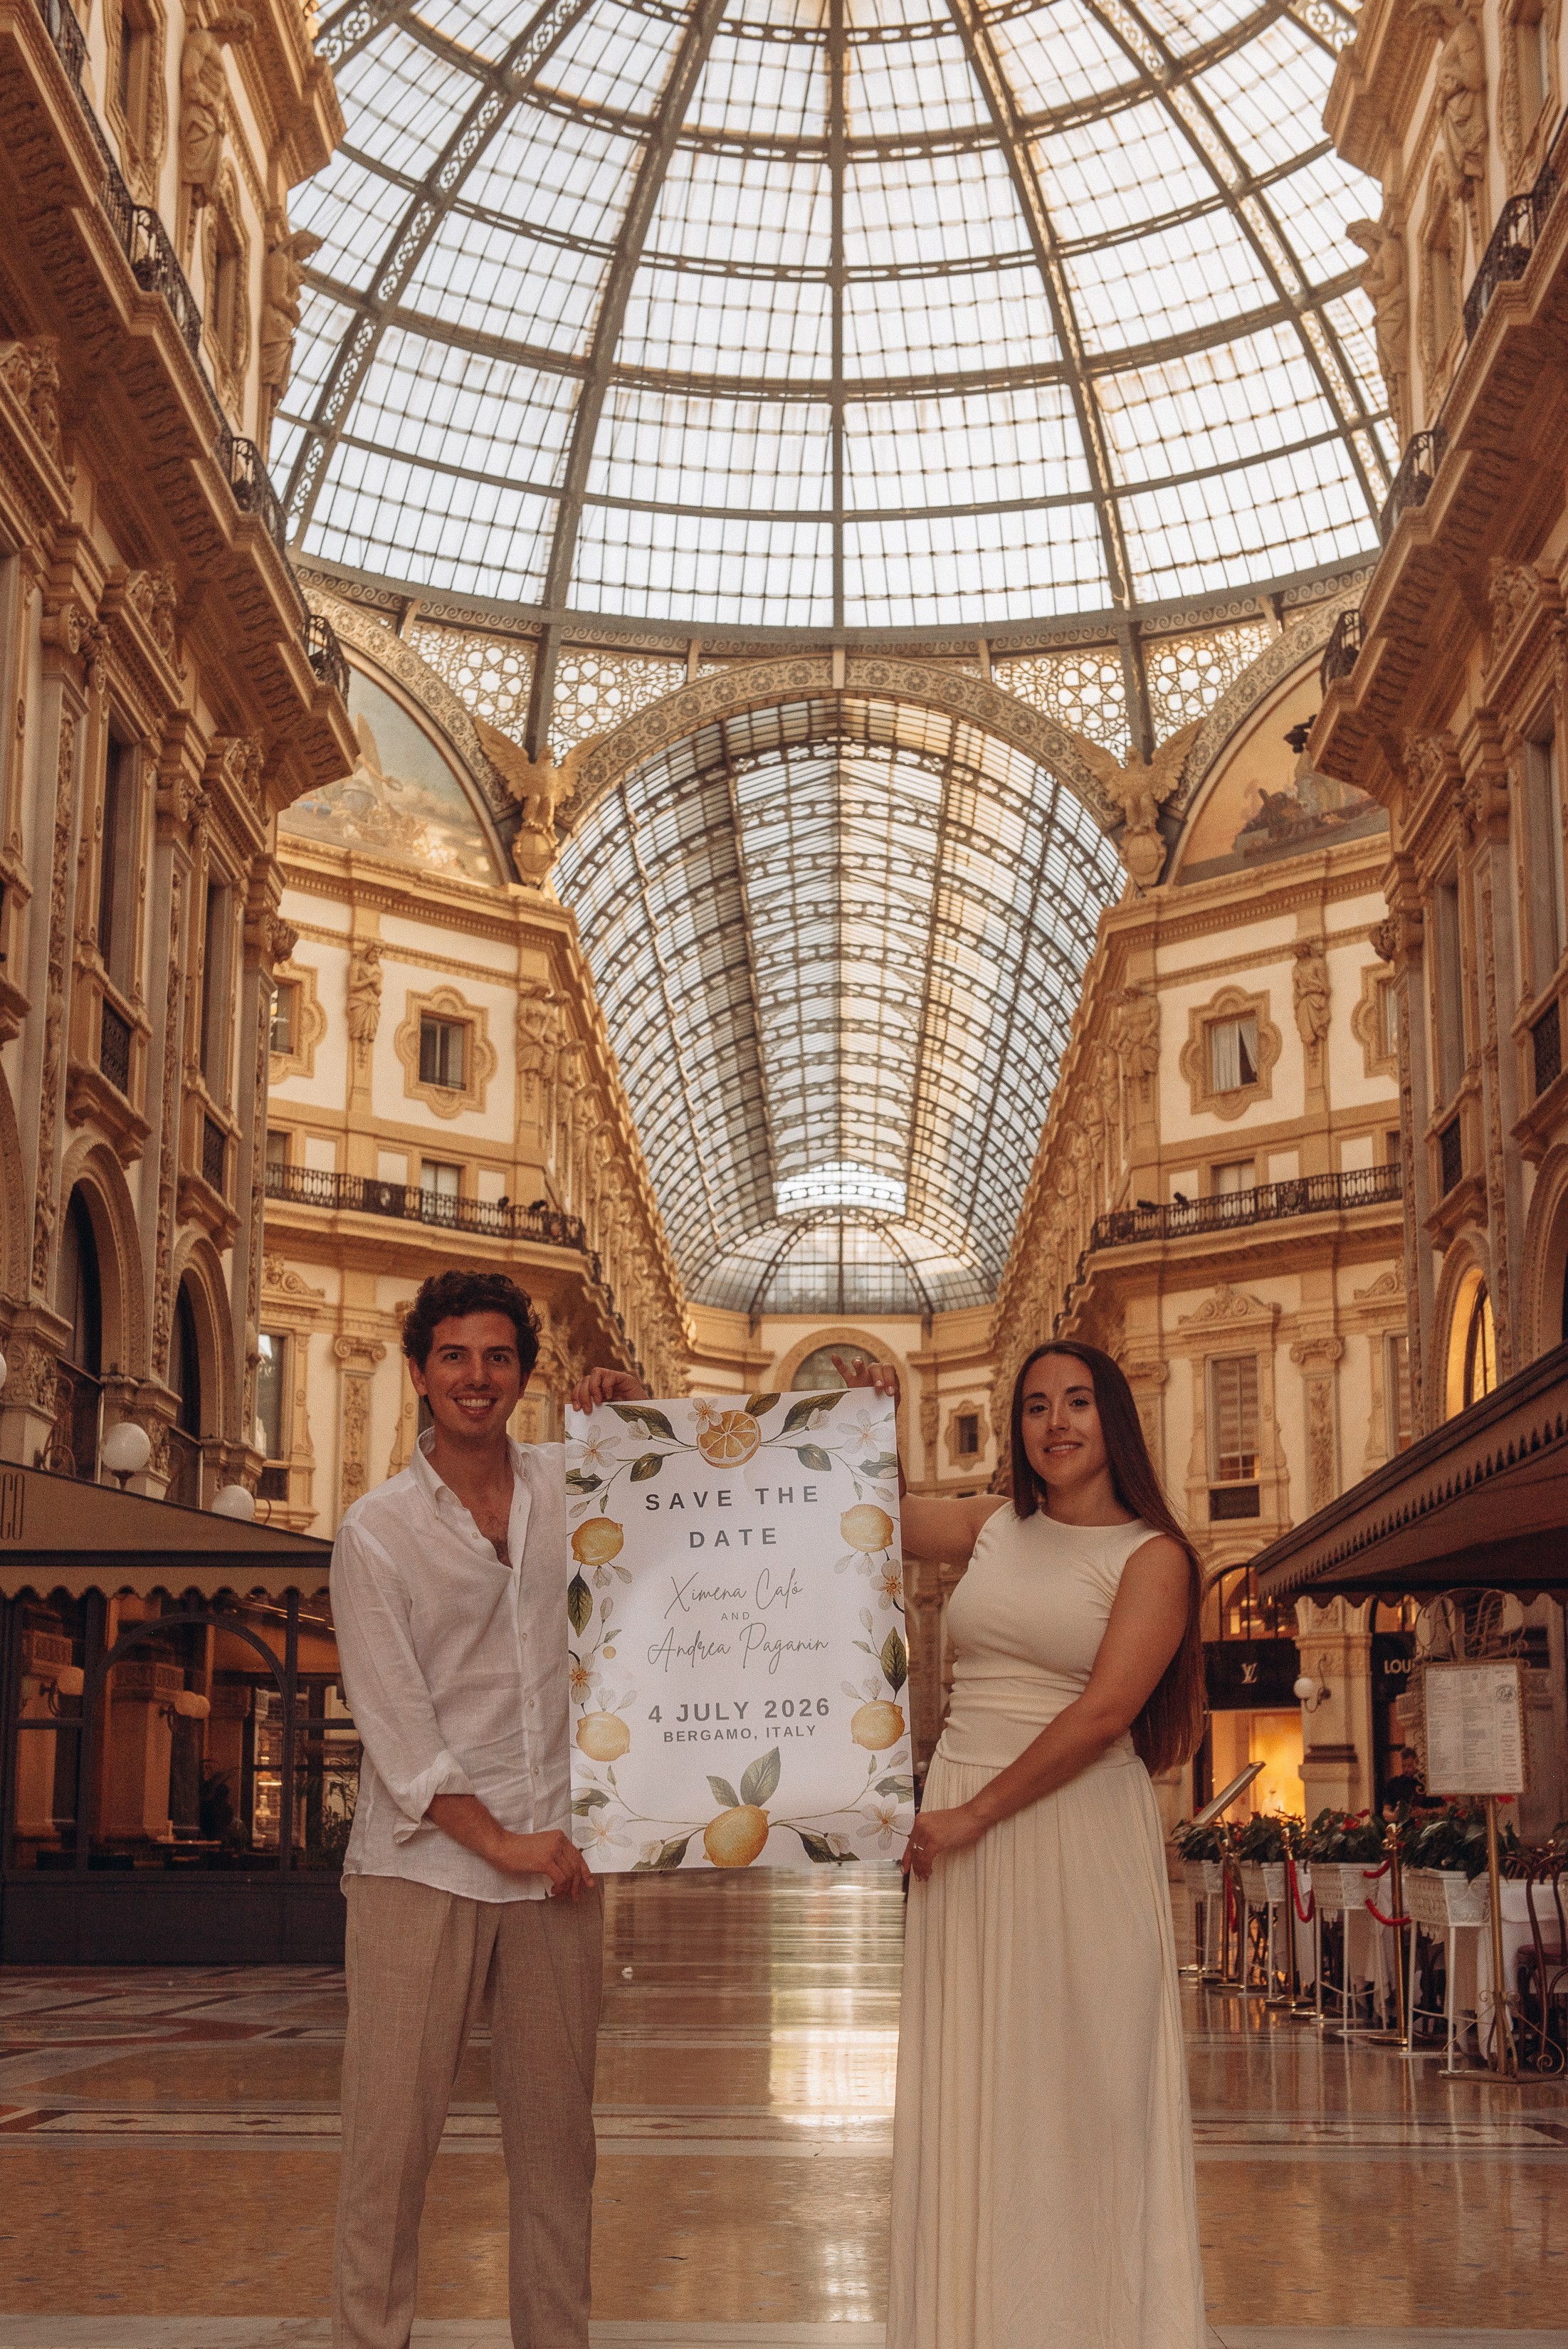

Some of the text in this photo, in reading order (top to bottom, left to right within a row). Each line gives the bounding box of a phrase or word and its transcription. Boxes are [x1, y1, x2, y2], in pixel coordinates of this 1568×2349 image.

[0, 1472, 25, 1540] CO
[645, 1486, 818, 1510] SAVE THE
[689, 1528, 777, 1548] DATE
[664, 1568, 803, 1619] Ximena Caló
[721, 1612, 749, 1621] AND
[648, 1622, 828, 1674] Andrea Paganin
[1384, 1659, 1414, 1674] LOU
[648, 1698, 829, 1723] 4 JULY 2026
[663, 1725, 816, 1743] BERGAMO, ITALY
